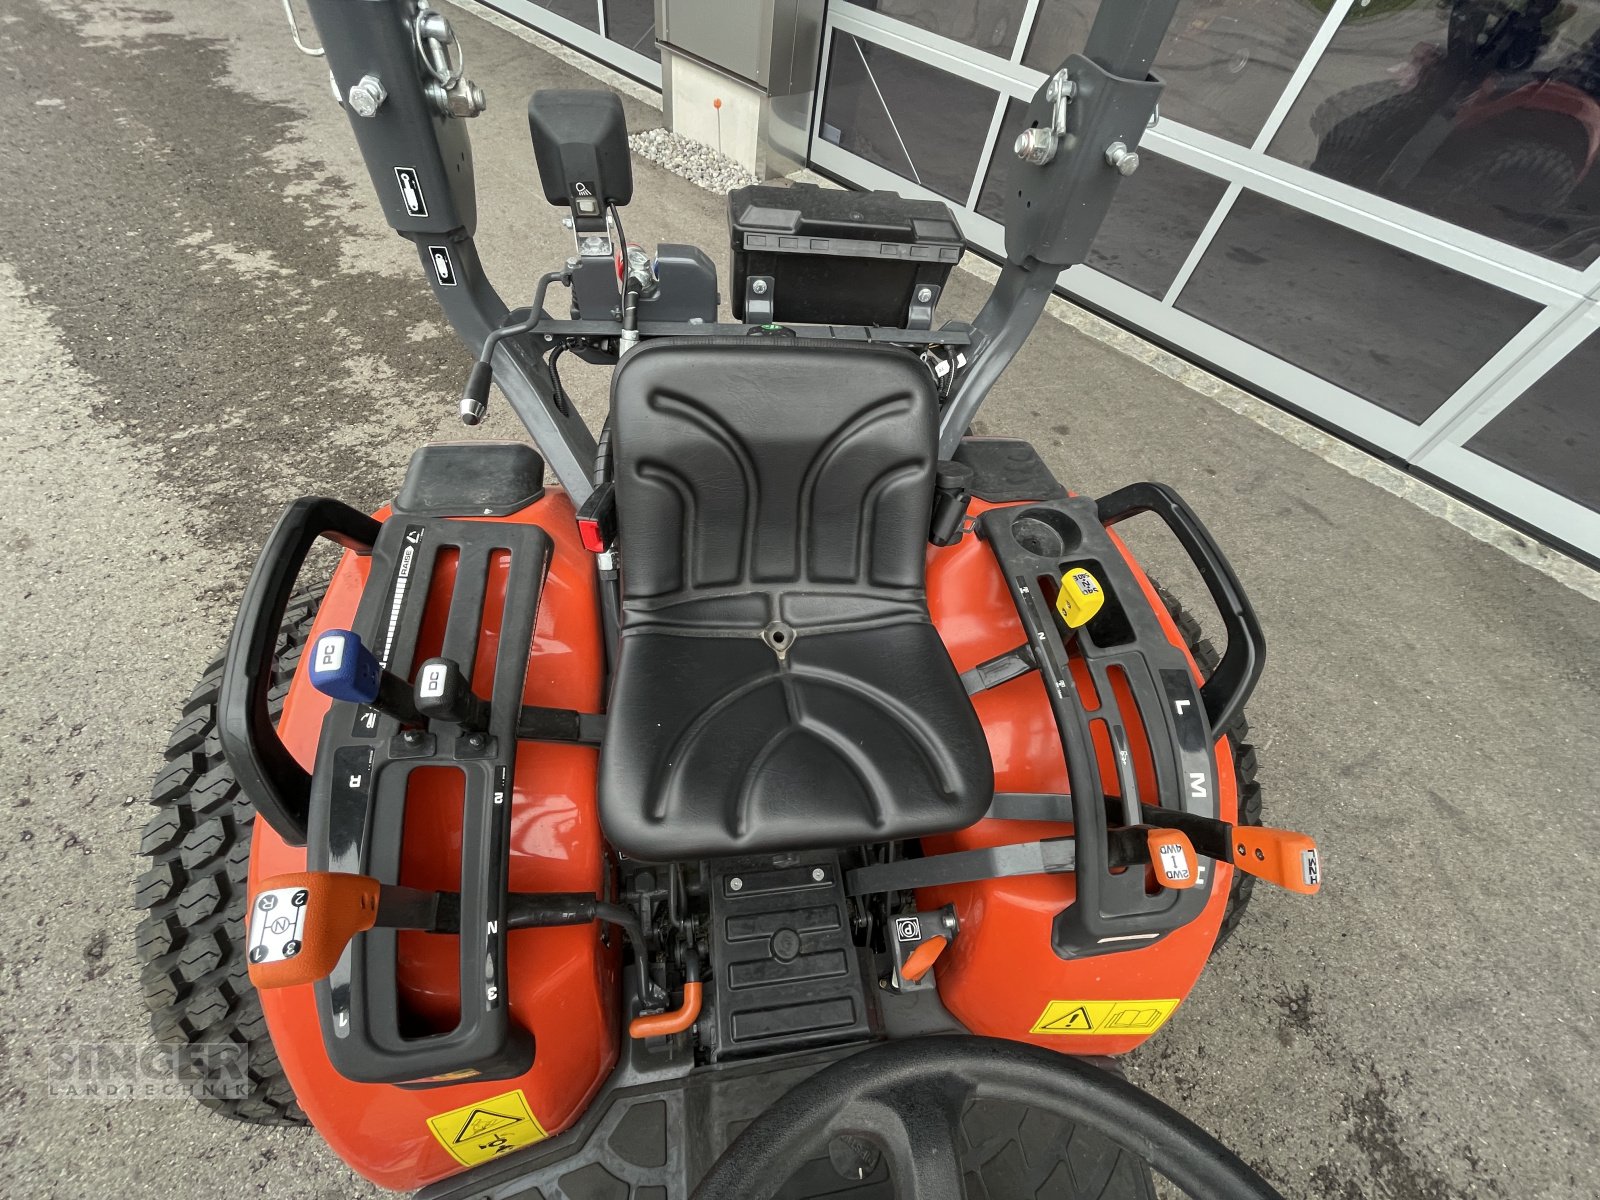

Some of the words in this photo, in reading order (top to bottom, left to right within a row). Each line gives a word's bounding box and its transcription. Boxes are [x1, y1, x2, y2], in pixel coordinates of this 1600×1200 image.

[401, 550, 412, 576] RAISE
[322, 644, 335, 665] PC
[428, 671, 440, 691] DC
[1175, 700, 1191, 715] L
[349, 775, 361, 788] R
[1189, 772, 1207, 798] M
[494, 792, 504, 804] 2
[1160, 845, 1182, 854] 4WD
[1166, 870, 1189, 879] 2WD
[263, 897, 275, 909] R
[295, 893, 306, 905] 2
[274, 920, 286, 932] N
[487, 920, 498, 934] N
[254, 950, 262, 960] 1
[286, 942, 296, 955] 3
[487, 986, 497, 1000] 3
[339, 1013, 348, 1027] 1
